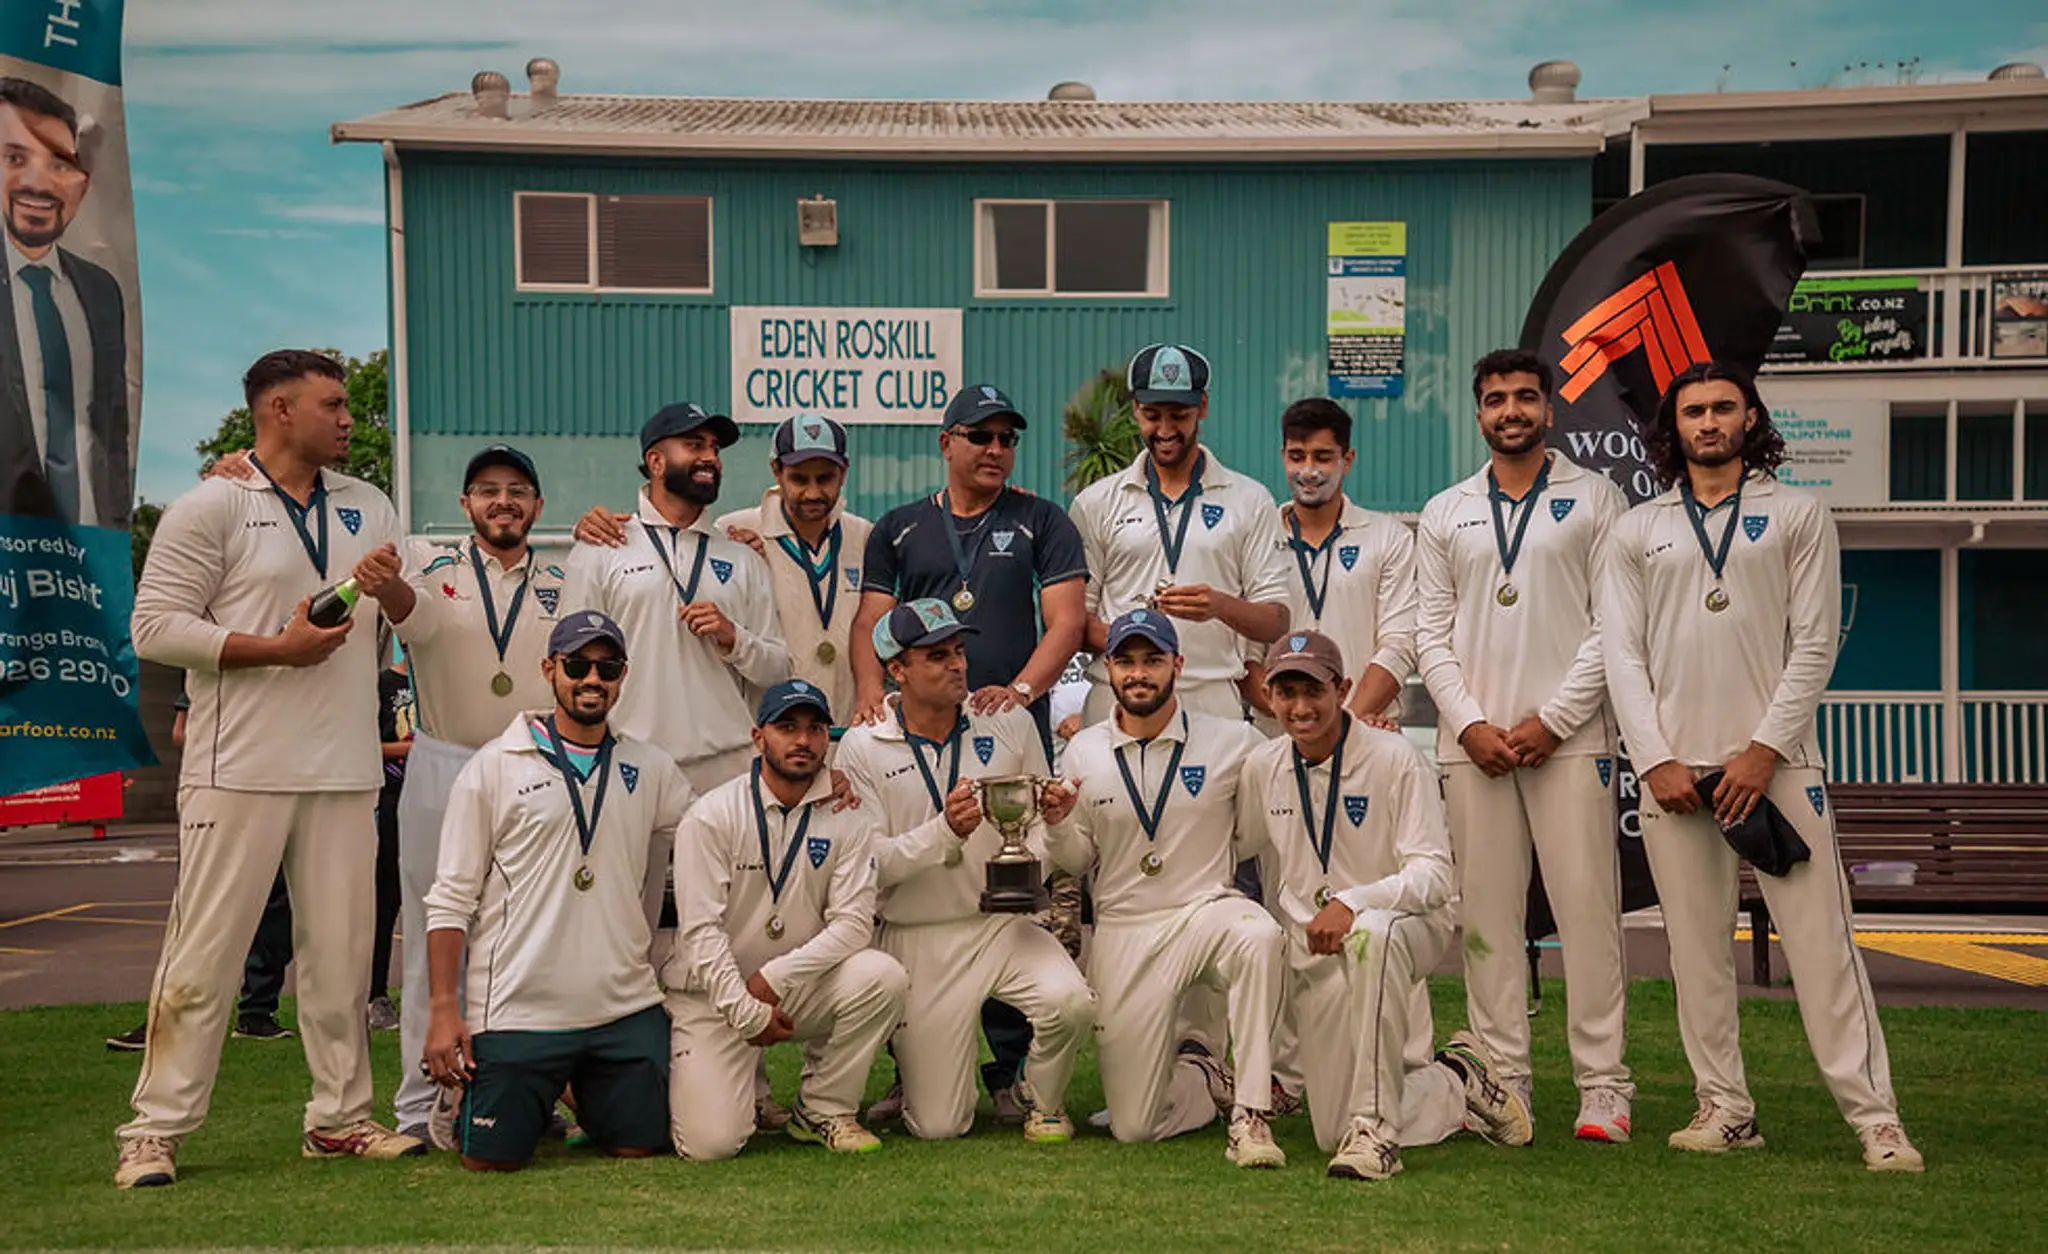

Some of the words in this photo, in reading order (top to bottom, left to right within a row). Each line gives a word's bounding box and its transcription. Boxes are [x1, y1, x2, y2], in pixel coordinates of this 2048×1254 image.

[761, 319, 827, 358] EDEN
[836, 319, 936, 359] ROSKILL
[746, 368, 862, 408] CRICKET
[876, 370, 948, 409] CLUB
[1565, 431, 1650, 467] WOO
[65, 538, 86, 565] by
[58, 658, 130, 697] 2970
